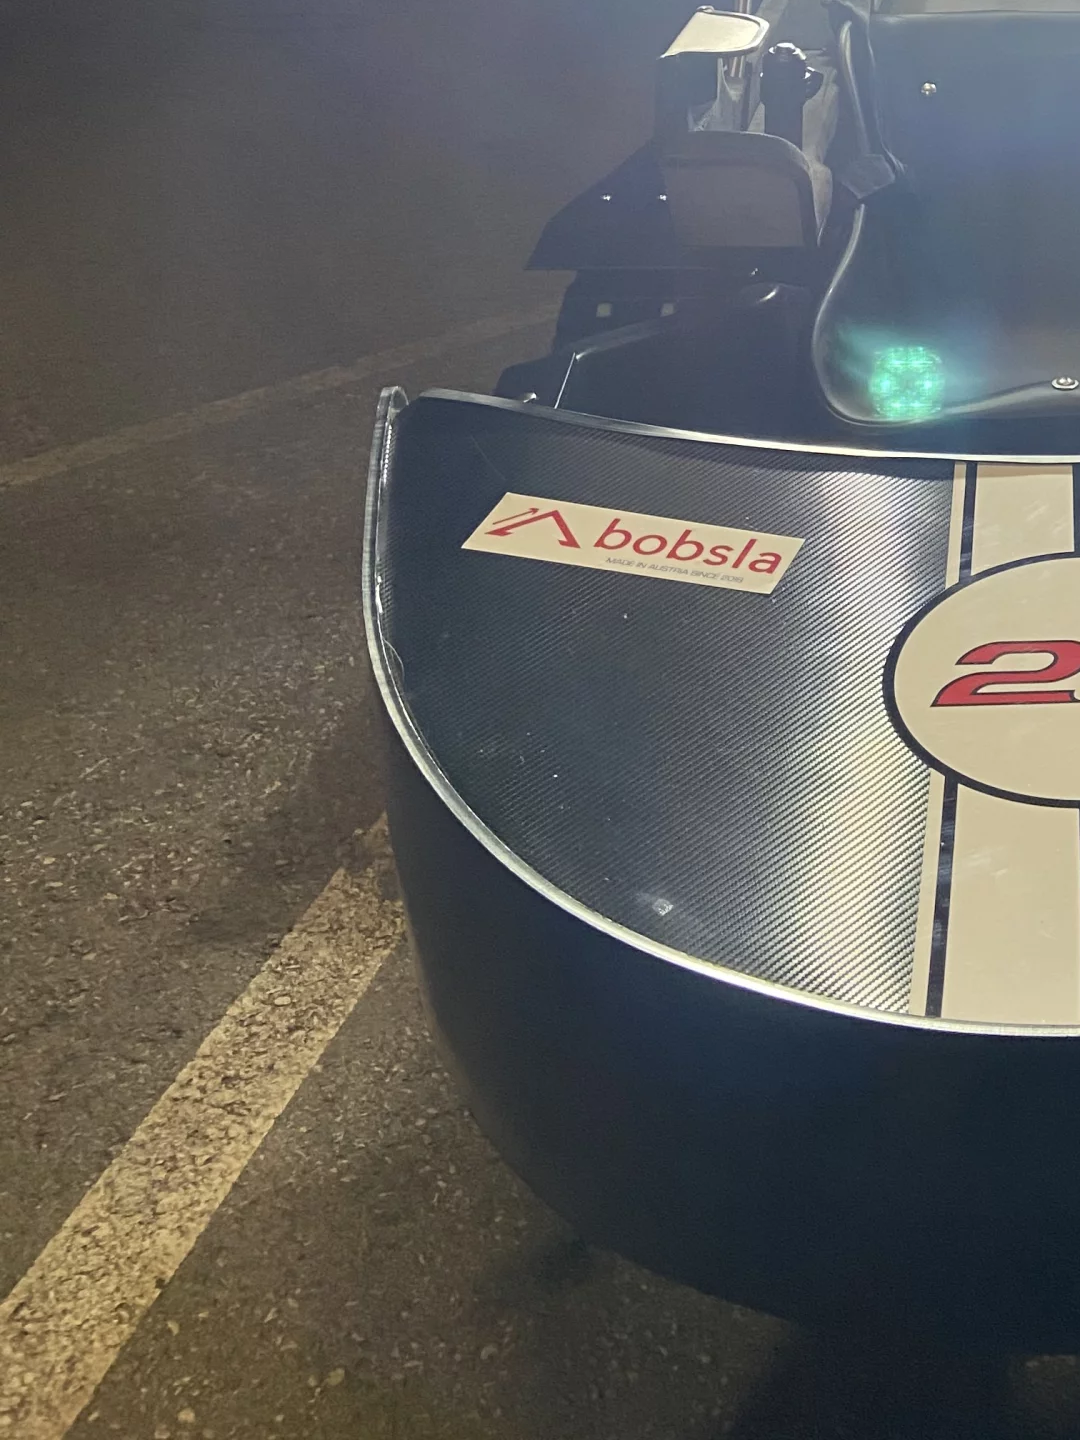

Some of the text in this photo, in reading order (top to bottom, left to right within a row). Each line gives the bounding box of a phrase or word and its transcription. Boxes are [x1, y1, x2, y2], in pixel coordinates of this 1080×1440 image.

[592, 517, 783, 575] bobsla
[605, 556, 634, 568] MADE
[647, 563, 689, 575] AUSTRIA
[690, 570, 720, 580] SINCE
